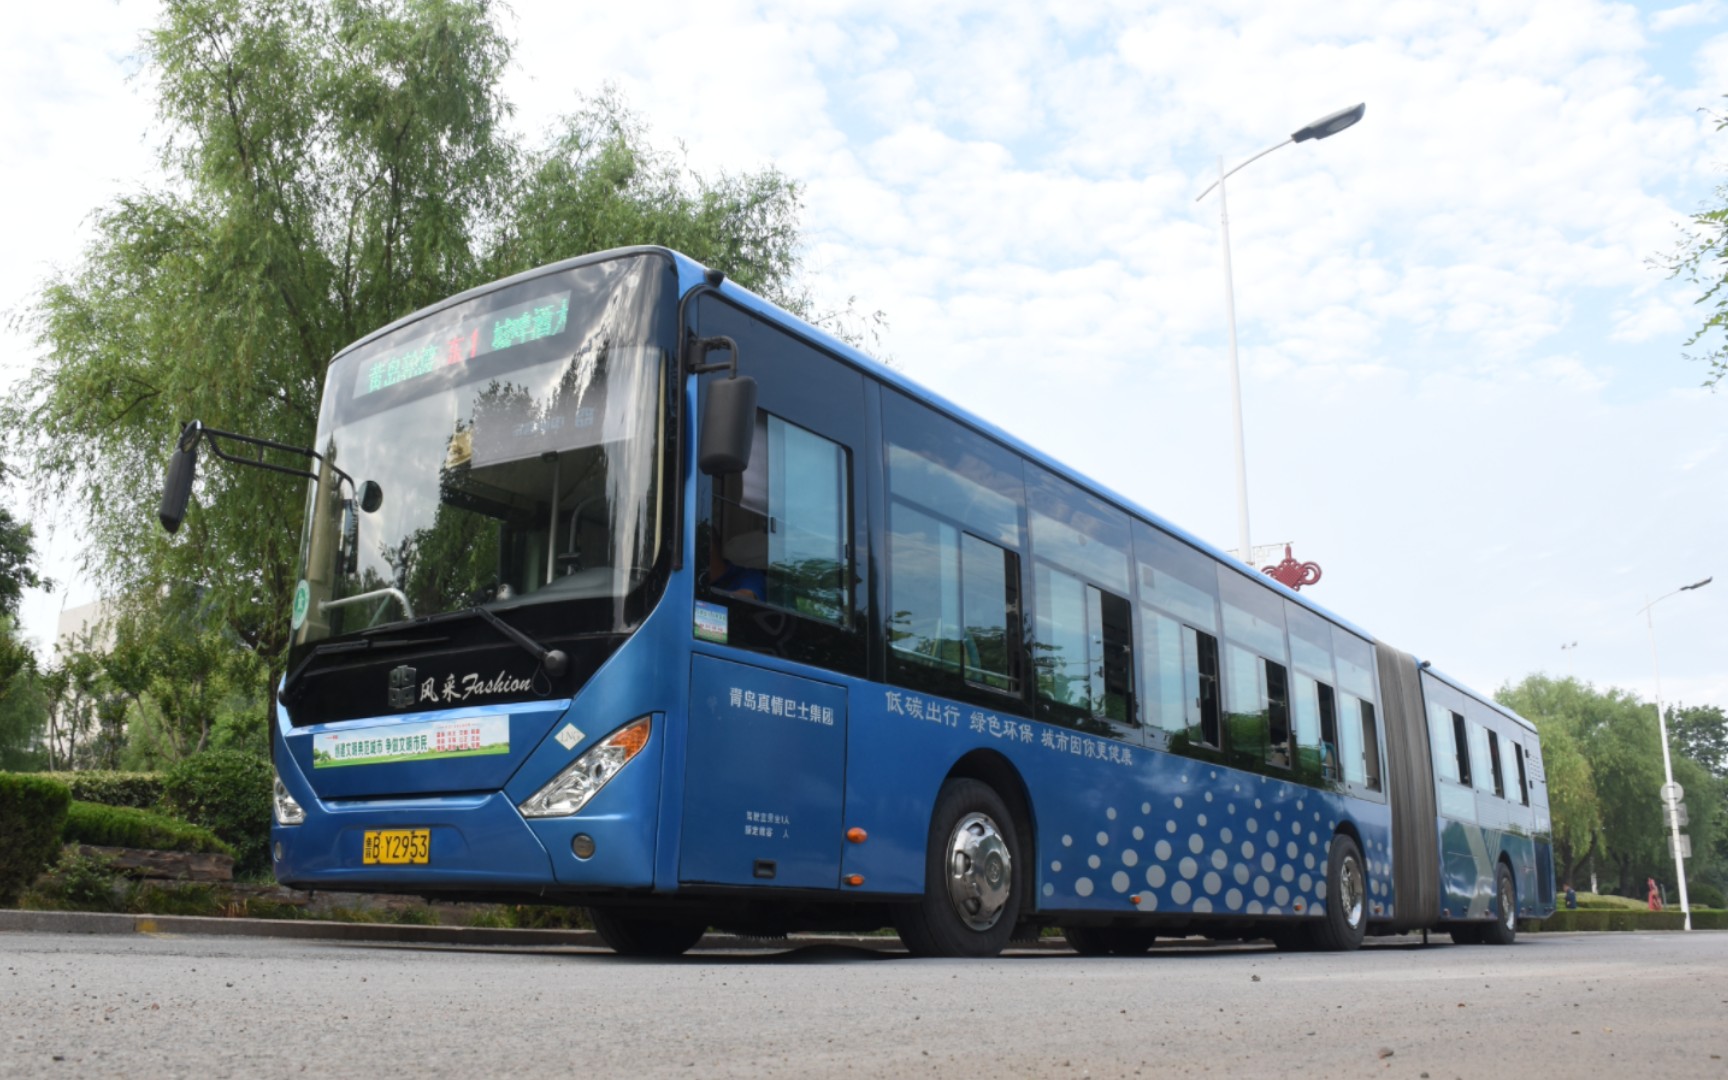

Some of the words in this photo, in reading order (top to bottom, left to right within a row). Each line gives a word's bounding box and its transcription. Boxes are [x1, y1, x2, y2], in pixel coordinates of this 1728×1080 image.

[419, 673, 461, 702] 风采
[461, 670, 531, 700] Fashion
[730, 687, 834, 726] 青岛真情巴士集团
[885, 691, 960, 728] 低碳出行
[970, 711, 1034, 743] 绿色环保
[1041, 729, 1133, 766] 城市因你更健康
